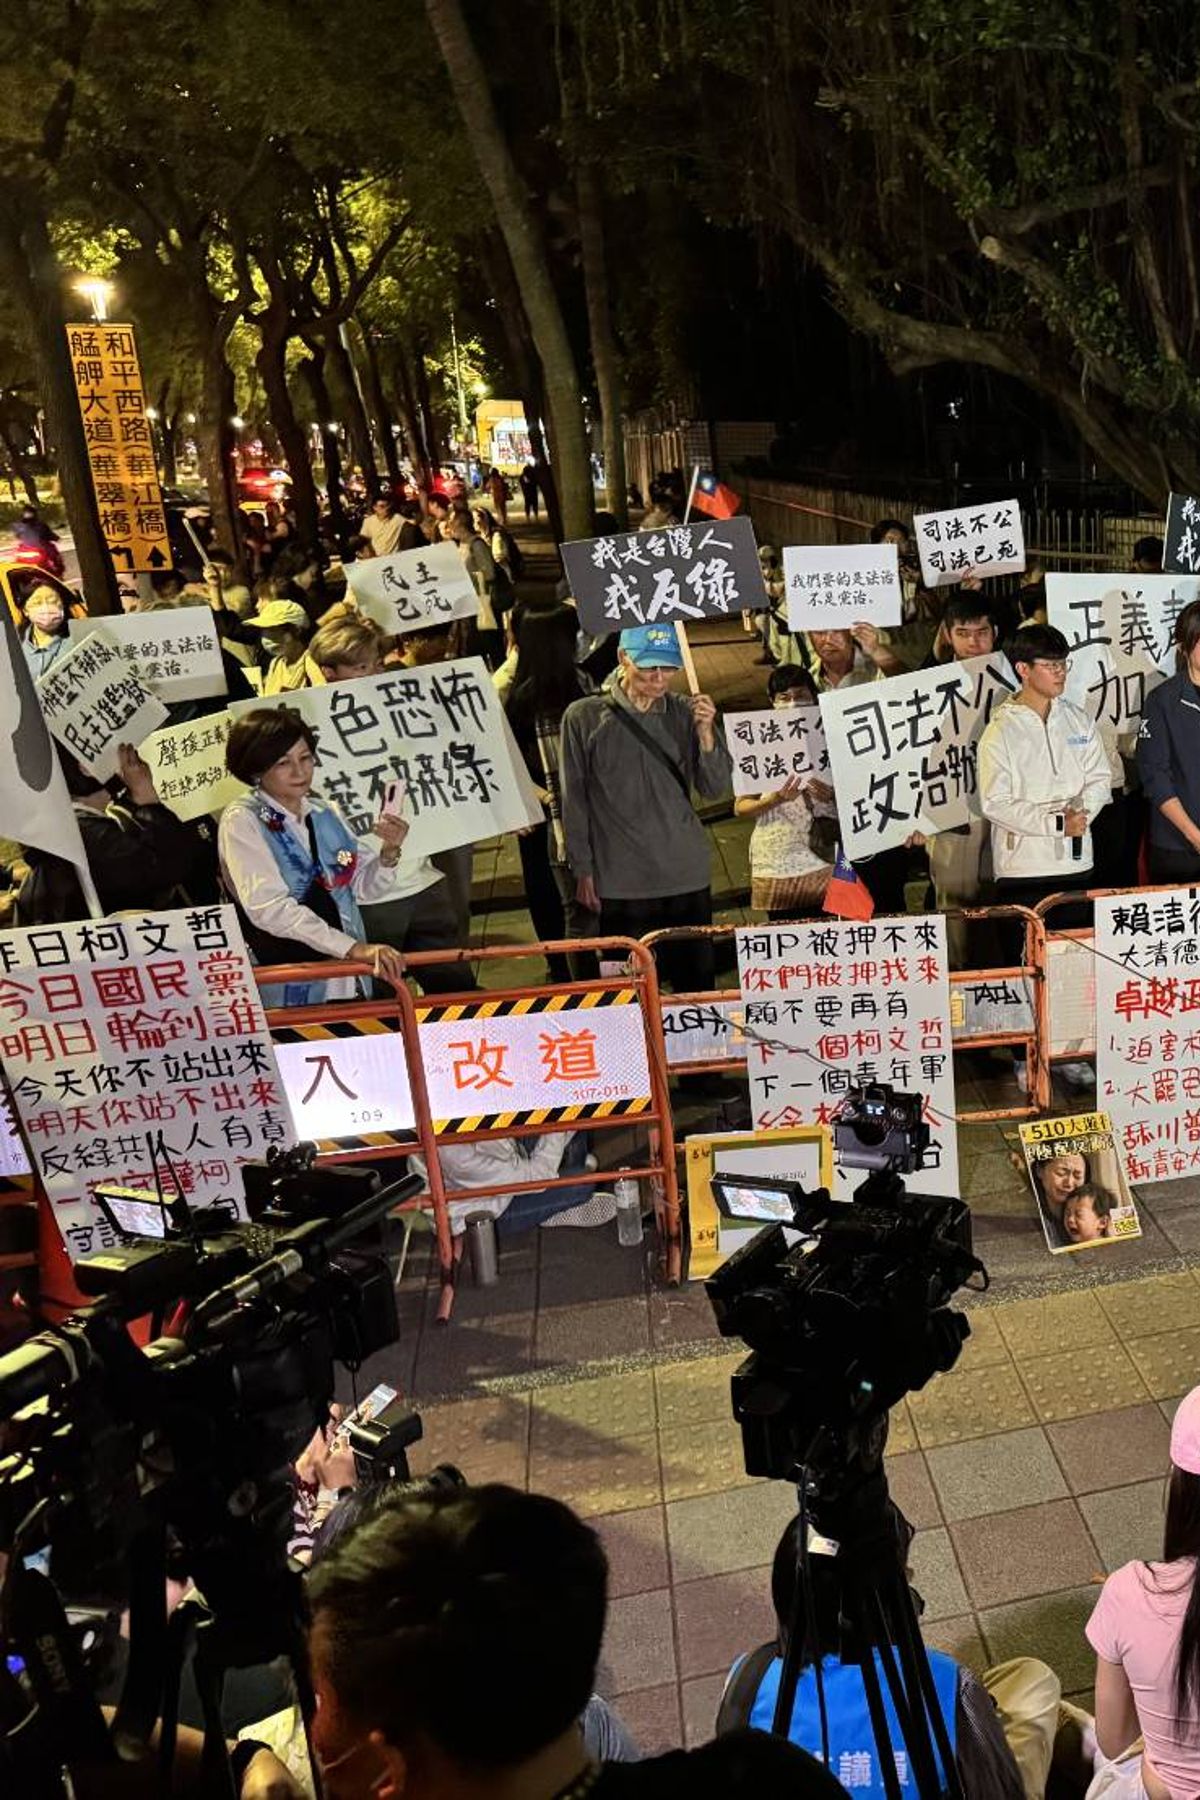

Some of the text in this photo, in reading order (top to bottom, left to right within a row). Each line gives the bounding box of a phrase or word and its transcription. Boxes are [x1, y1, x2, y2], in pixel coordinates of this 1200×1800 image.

[104, 331, 168, 543] 和平西路(華江橋)
[590, 527, 734, 570] 我是台灣人
[922, 509, 1013, 542] 司法不公
[791, 570, 896, 589] 我們要的是法治
[927, 540, 1018, 573] 司法已死
[602, 557, 740, 625] 我反綠
[738, 920, 939, 960] 柯P被押不來
[0, 950, 249, 1022] 今日國民黨
[1, 997, 265, 1063] 明日輪到誰
[751, 1016, 944, 1065] 下一個柯文哲
[13, 1040, 272, 1106] 今天你不站出來
[754, 1053, 947, 1099] 下一個青年軍
[26, 1076, 280, 1138] 明天你站不出來
